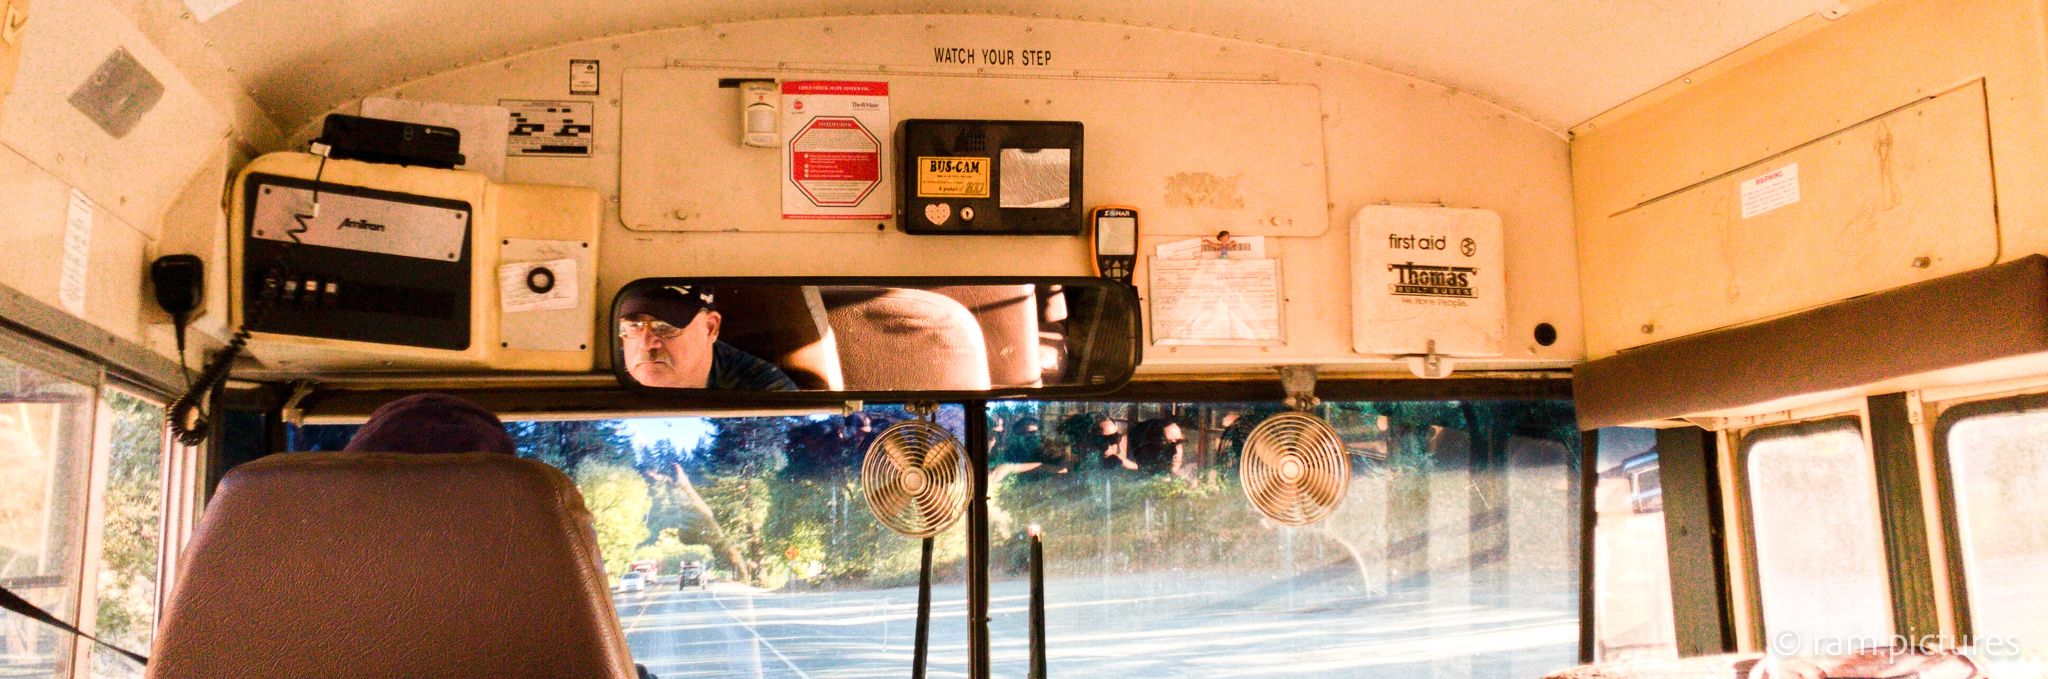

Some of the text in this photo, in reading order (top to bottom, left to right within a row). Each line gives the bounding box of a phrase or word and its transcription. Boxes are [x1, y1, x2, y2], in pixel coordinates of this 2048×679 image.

[934, 47, 1051, 66] WATCH YOUR STEP
[930, 160, 980, 173] BUS-CAM
[1389, 233, 1446, 250] first aid
[1394, 262, 1469, 288] Thomas
[1398, 286, 1470, 296] BUILT BUSES
